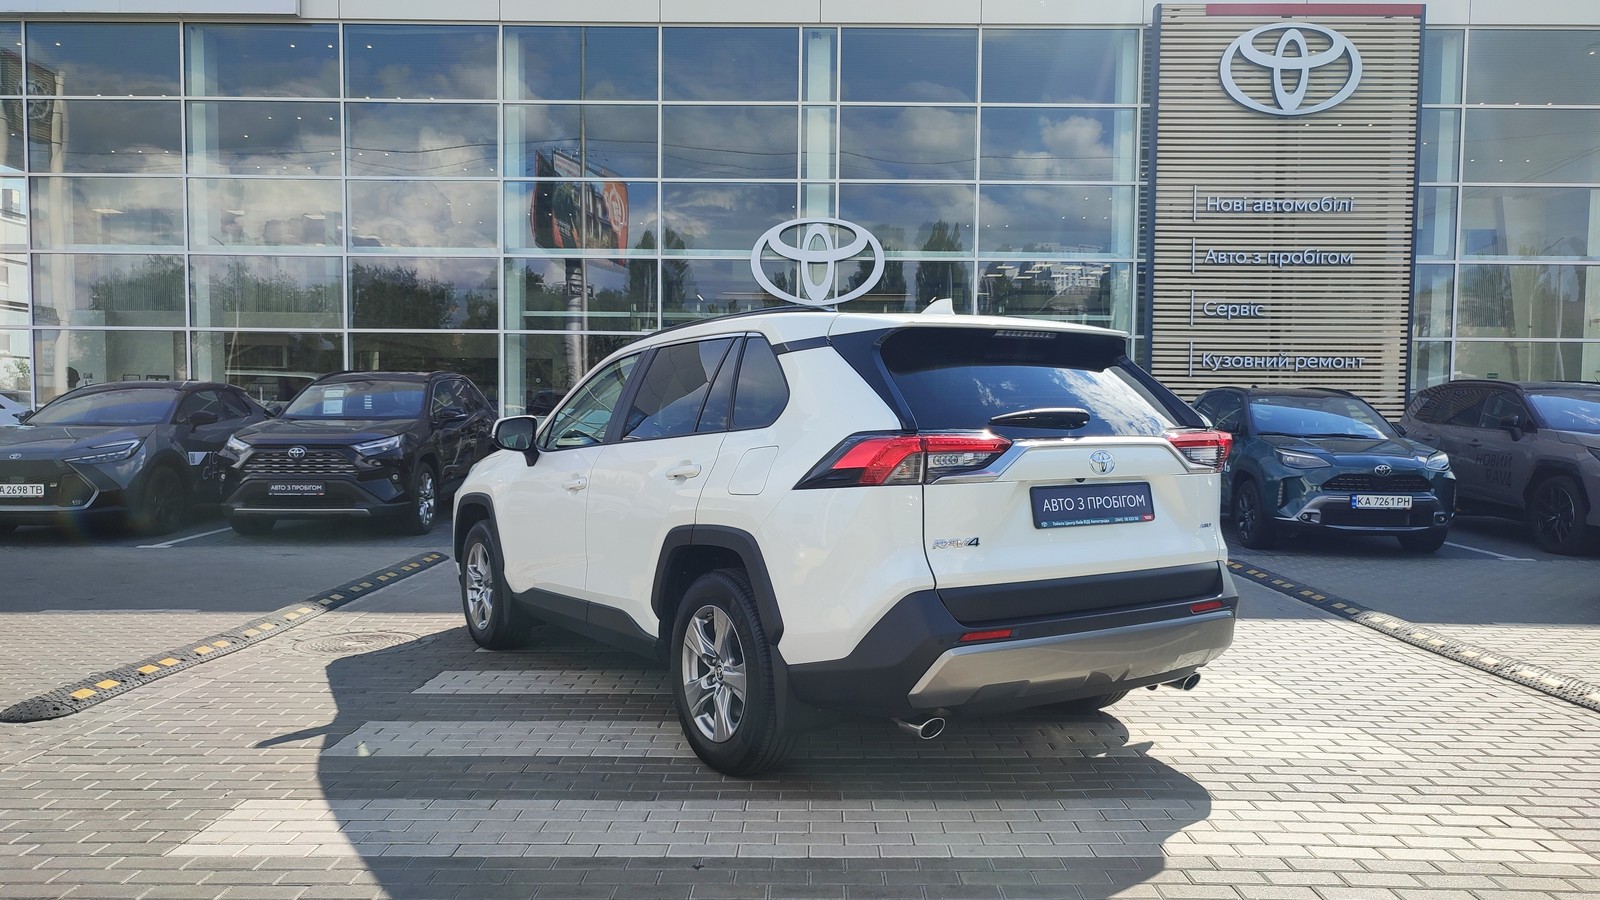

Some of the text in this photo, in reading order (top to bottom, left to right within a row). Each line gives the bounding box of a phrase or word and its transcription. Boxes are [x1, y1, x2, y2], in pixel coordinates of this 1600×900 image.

[1206, 196, 1355, 213] Нові автомобілі
[1203, 248, 1354, 268] Авто з пробігом
[1202, 300, 1265, 320] Сервіс
[1201, 352, 1366, 372] Кузовний ремонт
[6, 485, 28, 495] 2698
[30, 485, 43, 495] TB
[1043, 494, 1147, 512] АВТО З ПРОБІГОМ
[1357, 496, 1410, 507] KA 7261 PH
[932, 537, 980, 550] RAV4
